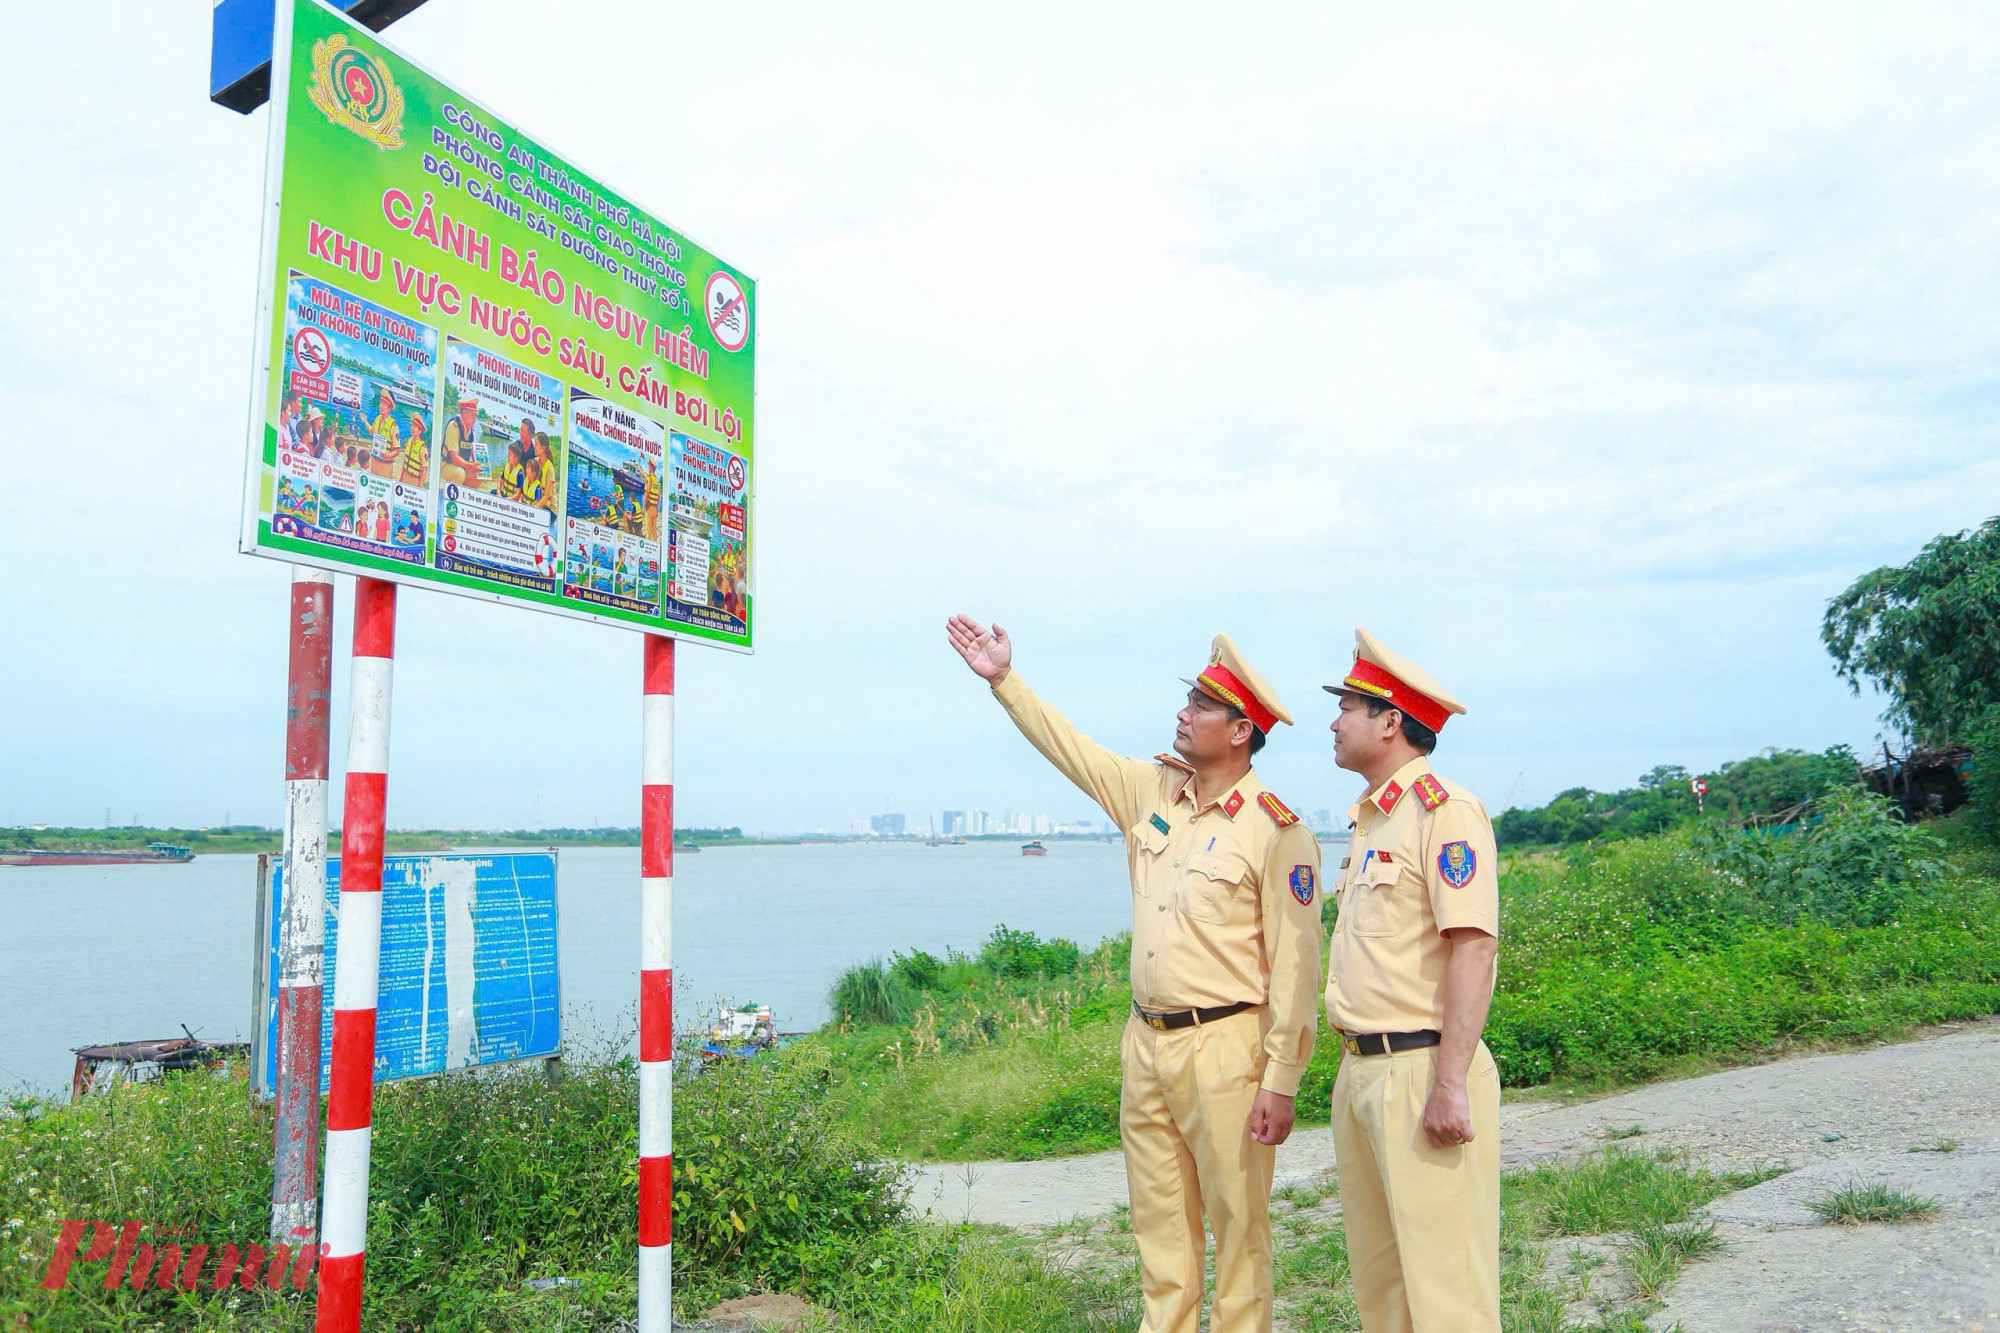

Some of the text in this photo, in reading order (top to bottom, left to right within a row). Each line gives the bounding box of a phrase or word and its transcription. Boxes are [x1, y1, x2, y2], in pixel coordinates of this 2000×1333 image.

[443, 104, 681, 261] CÔNG AN THÀNH PHỐ HÀ NỘI
[433, 126, 686, 287] PHÒNG CẢNH SÁT GIAO THÔNG
[424, 152, 690, 315] ĐỘI CẢNH SÁT ĐƯỜNG THUỶ SỐ 1
[382, 188, 709, 379] CẢNH BÁO NGUY HIỂM
[310, 286, 341, 313] MÙA
[344, 299, 362, 321] HÈ
[363, 310, 381, 329] AN
[384, 317, 415, 343] TOÀN
[298, 304, 430, 366] NÓI KHÔNG VỚI ĐUỐI NƯỚC
[308, 220, 742, 444] KHU VỰC NƯỚC SÂU, CẤM BƠI LỘI
[477, 352, 541, 390] PHÒNG NGỪA
[453, 362, 560, 415] TAI NẠN ĐUỐI NƯỚC CHO TRẺ EM
[602, 405, 636, 430] KỸ NĂNG
[603, 423, 627, 443] CHỐNG
[628, 432, 643, 450] ĐUỐI
[645, 439, 662, 457] NƯỚC
[686, 439, 724, 463] CHUNG TAY
[325, 467, 330, 475] 2
[676, 467, 685, 481] TAI
[688, 471, 701, 487] NẠN
[682, 452, 706, 472] PHÒNG
[397, 487, 401, 495] 4
[462, 491, 466, 499] 1.
[671, 550, 675, 559] 2
[672, 533, 675, 542] 1
